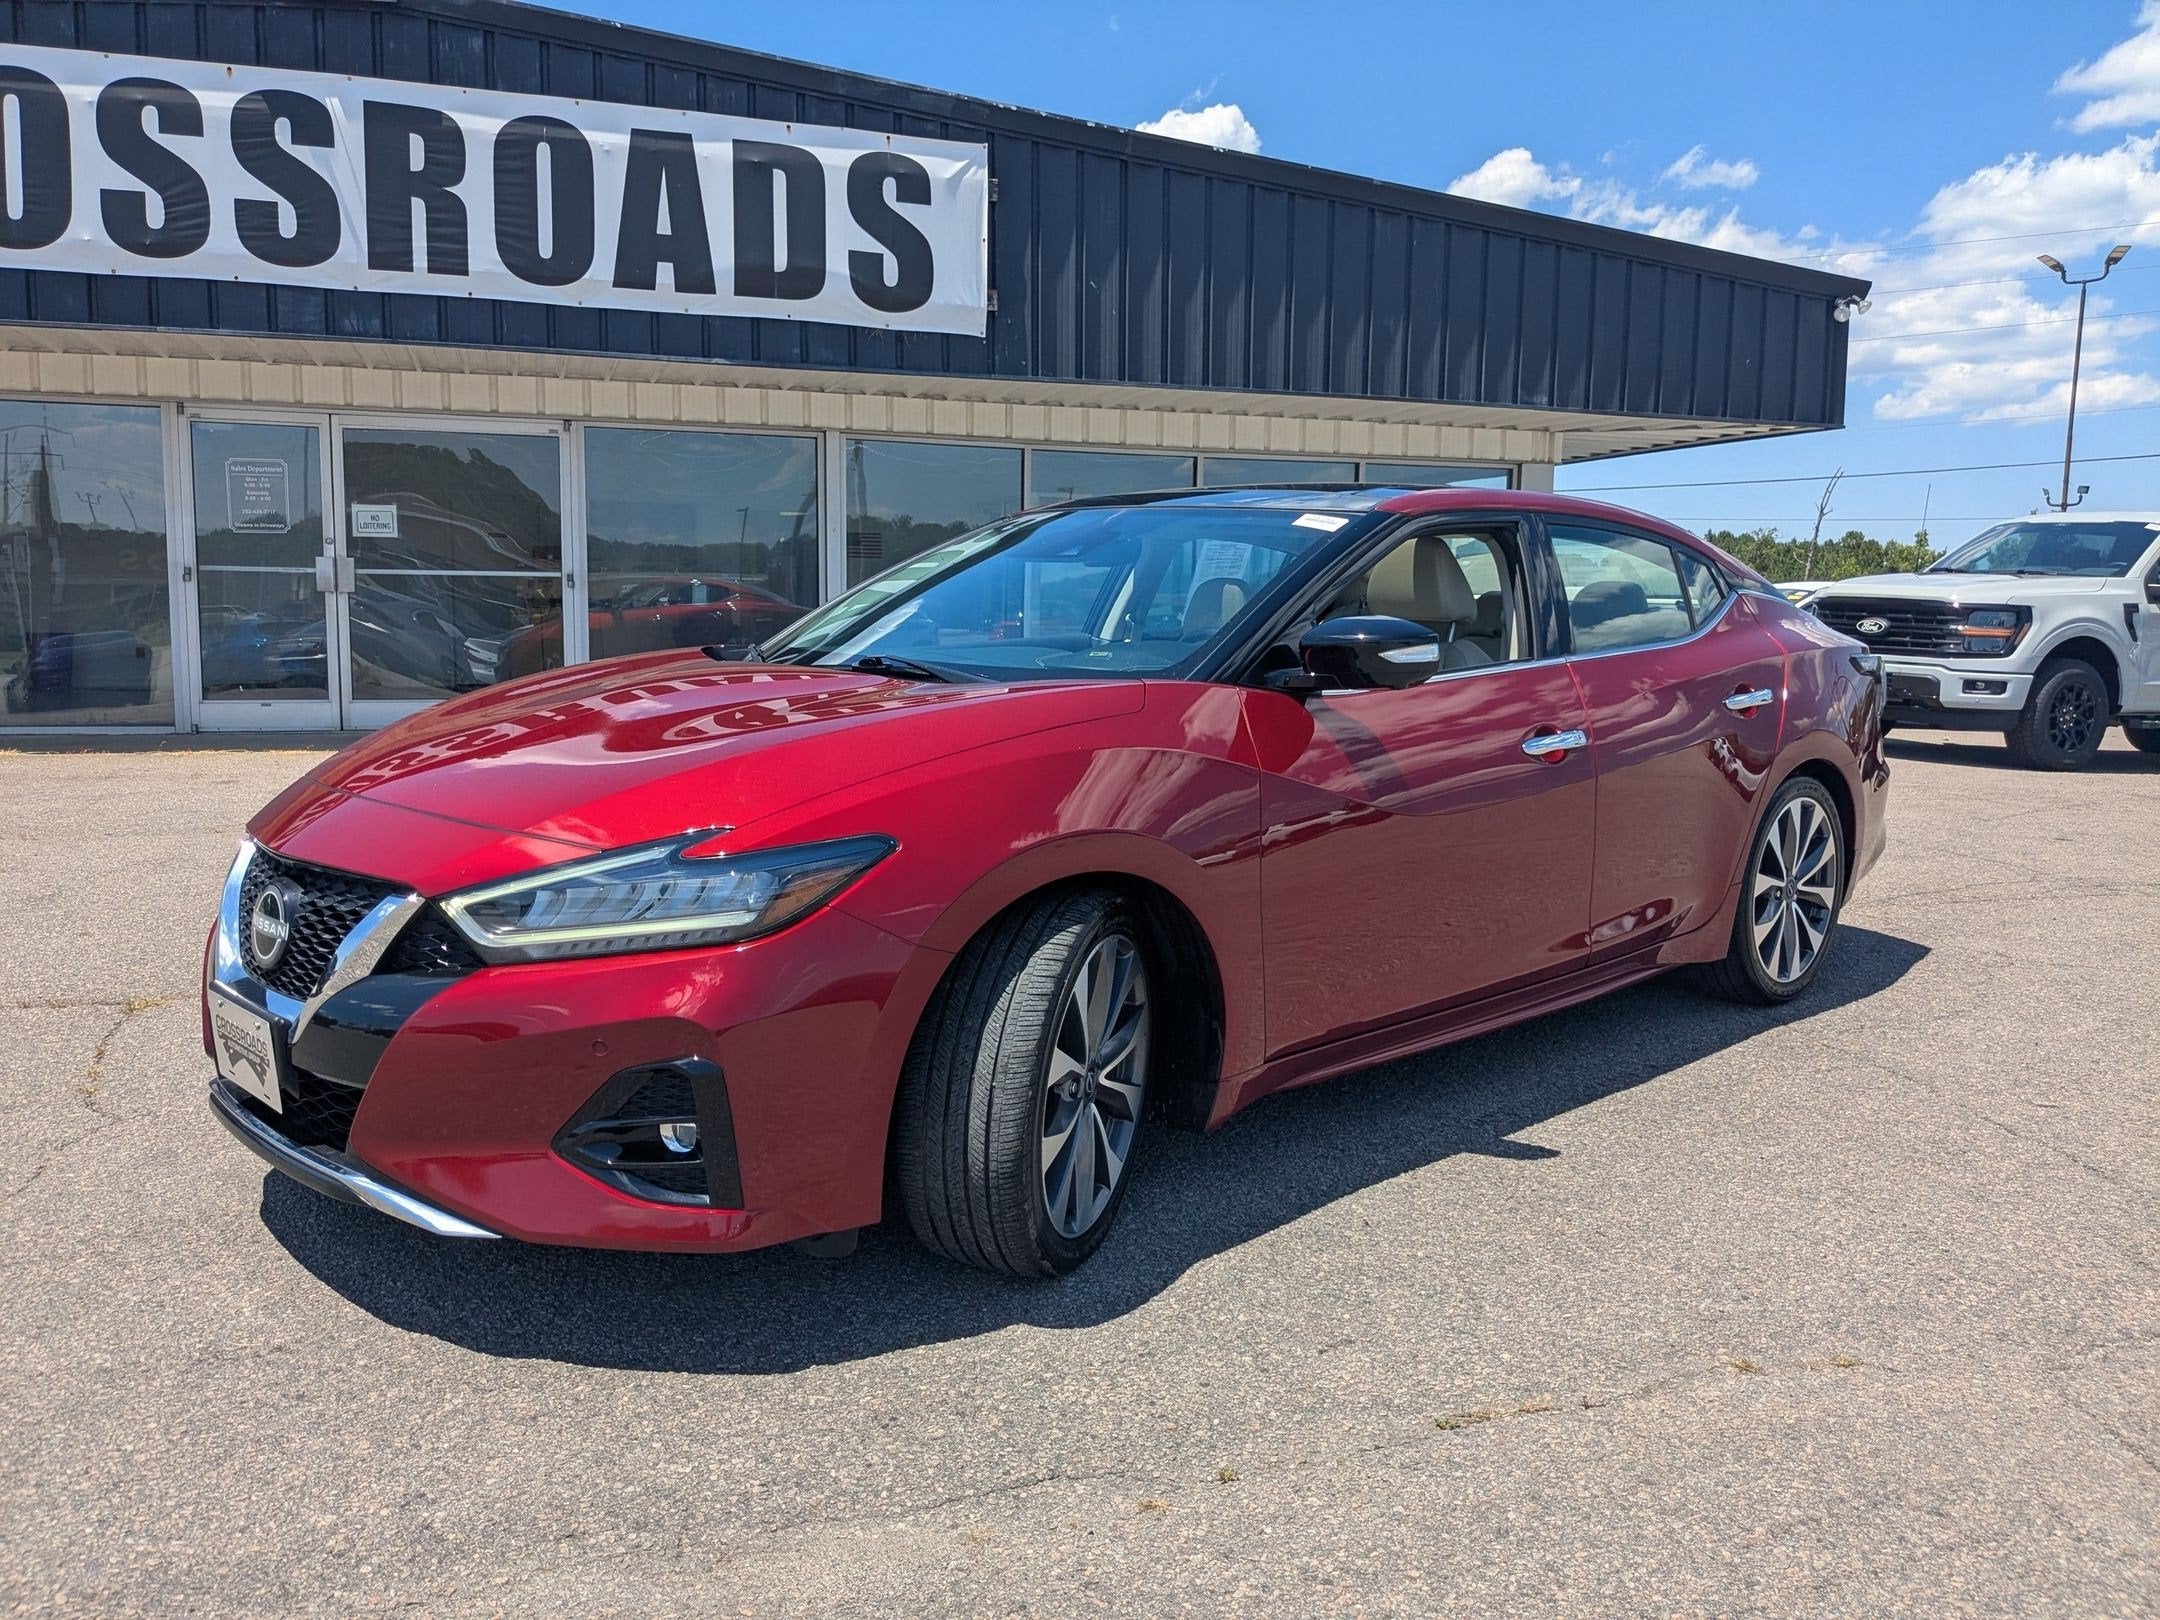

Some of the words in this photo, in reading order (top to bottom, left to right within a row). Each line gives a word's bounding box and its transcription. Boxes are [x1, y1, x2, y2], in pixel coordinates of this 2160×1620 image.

[0, 65, 935, 313] OSSROADS
[230, 464, 247, 472] Sales
[248, 465, 283, 474] Department
[360, 522, 391, 530] LOITERING
[1860, 621, 1880, 631] Ford
[215, 1014, 268, 1058] CROSSROADS
